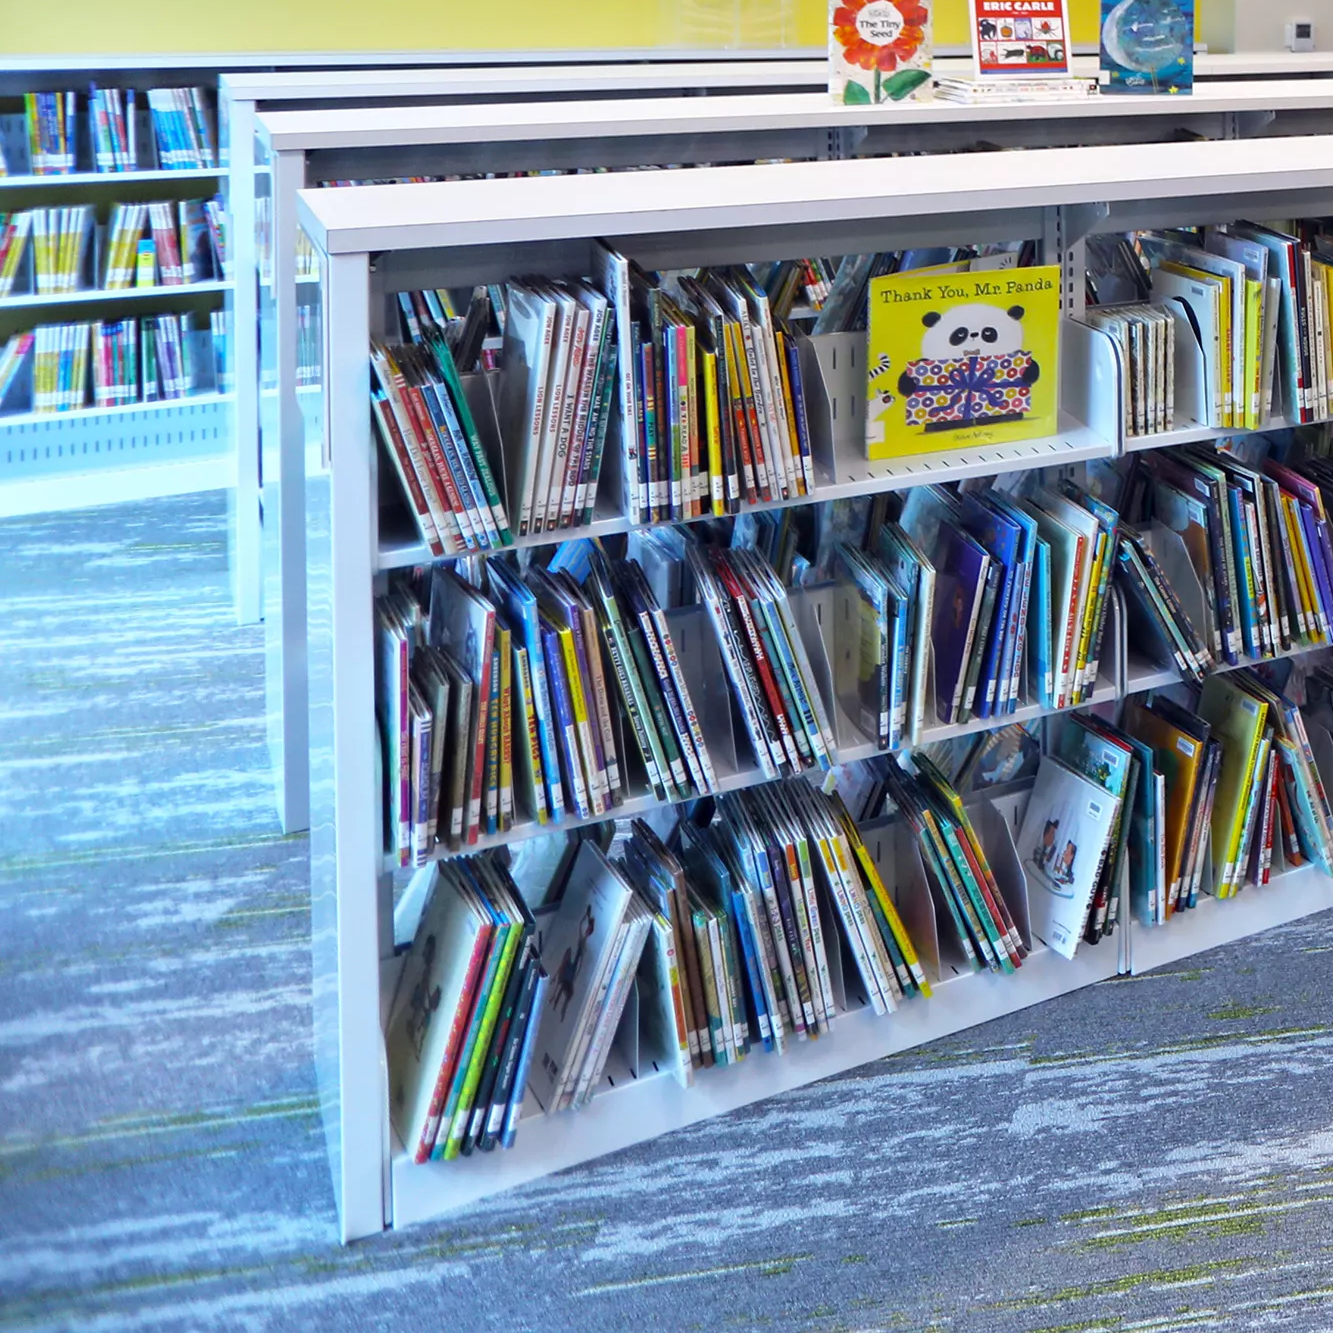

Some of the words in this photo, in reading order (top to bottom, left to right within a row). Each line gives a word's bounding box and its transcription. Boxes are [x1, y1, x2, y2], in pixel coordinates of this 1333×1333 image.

[983, 2, 1012, 11] ERIC
[1014, 2, 1054, 11] CARLE
[870, 30, 893, 38] Seed
[881, 21, 899, 30] Tiny
[880, 288, 932, 304] Thank
[939, 284, 969, 300] You,
[975, 283, 1001, 296] Mr.
[1006, 277, 1054, 295] Panda
[594, 308, 603, 325] JON
[591, 326, 600, 341] AGEE
[535, 386, 544, 403] LION
[553, 383, 562, 401] LION
[531, 404, 541, 435] LESSONS
[547, 402, 559, 433] LESSONS
[561, 401, 573, 424] WANT
[574, 413, 586, 442] MIDDLE
[680, 425, 688, 443] READ
[468, 434, 480, 450] WAY
[555, 436, 567, 457] DOG
[1094, 858, 1104, 878] BAD
[1087, 880, 1098, 900] GUY
[843, 910, 854, 927] peas
[855, 909, 866, 925] peas
[811, 927, 823, 944] peas
